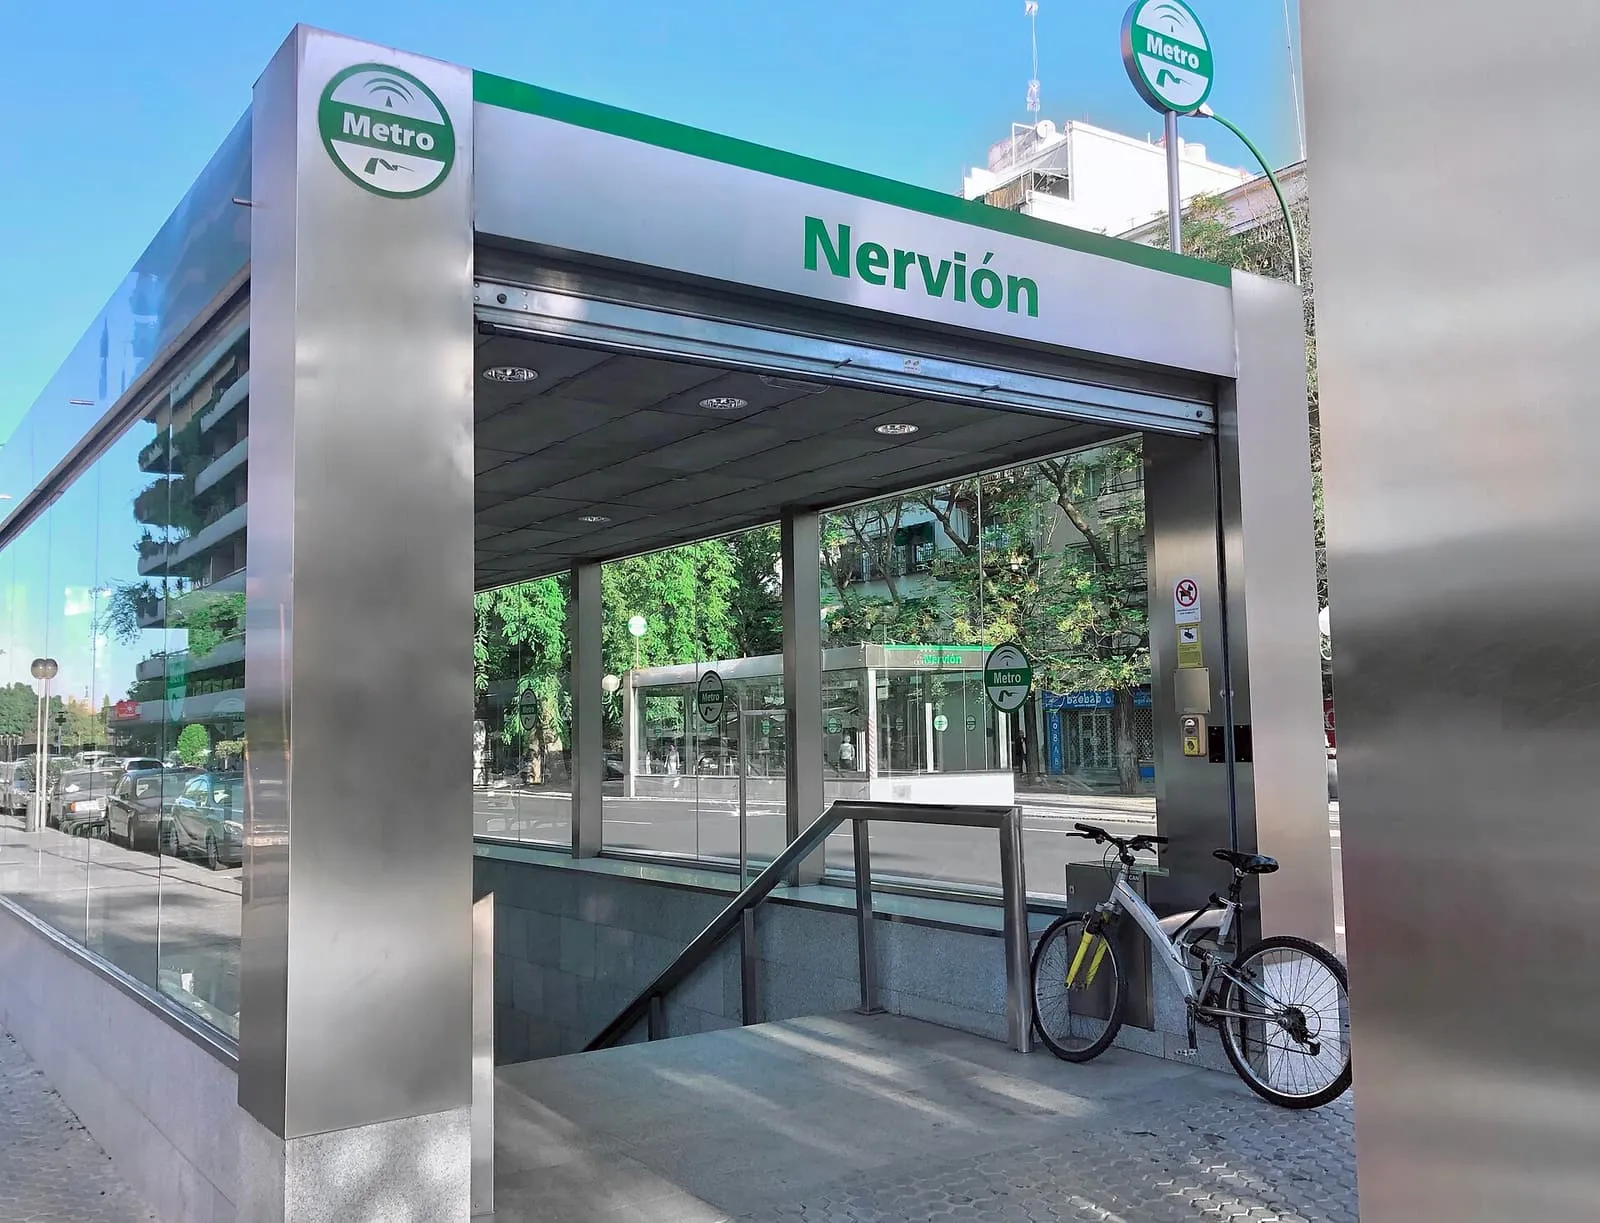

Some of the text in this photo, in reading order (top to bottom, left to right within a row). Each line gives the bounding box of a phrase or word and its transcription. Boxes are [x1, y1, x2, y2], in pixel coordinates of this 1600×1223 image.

[1146, 33, 1200, 69] Metro
[342, 111, 435, 151] Metro
[804, 215, 1039, 318] Nervión
[993, 671, 1022, 684] Metro
